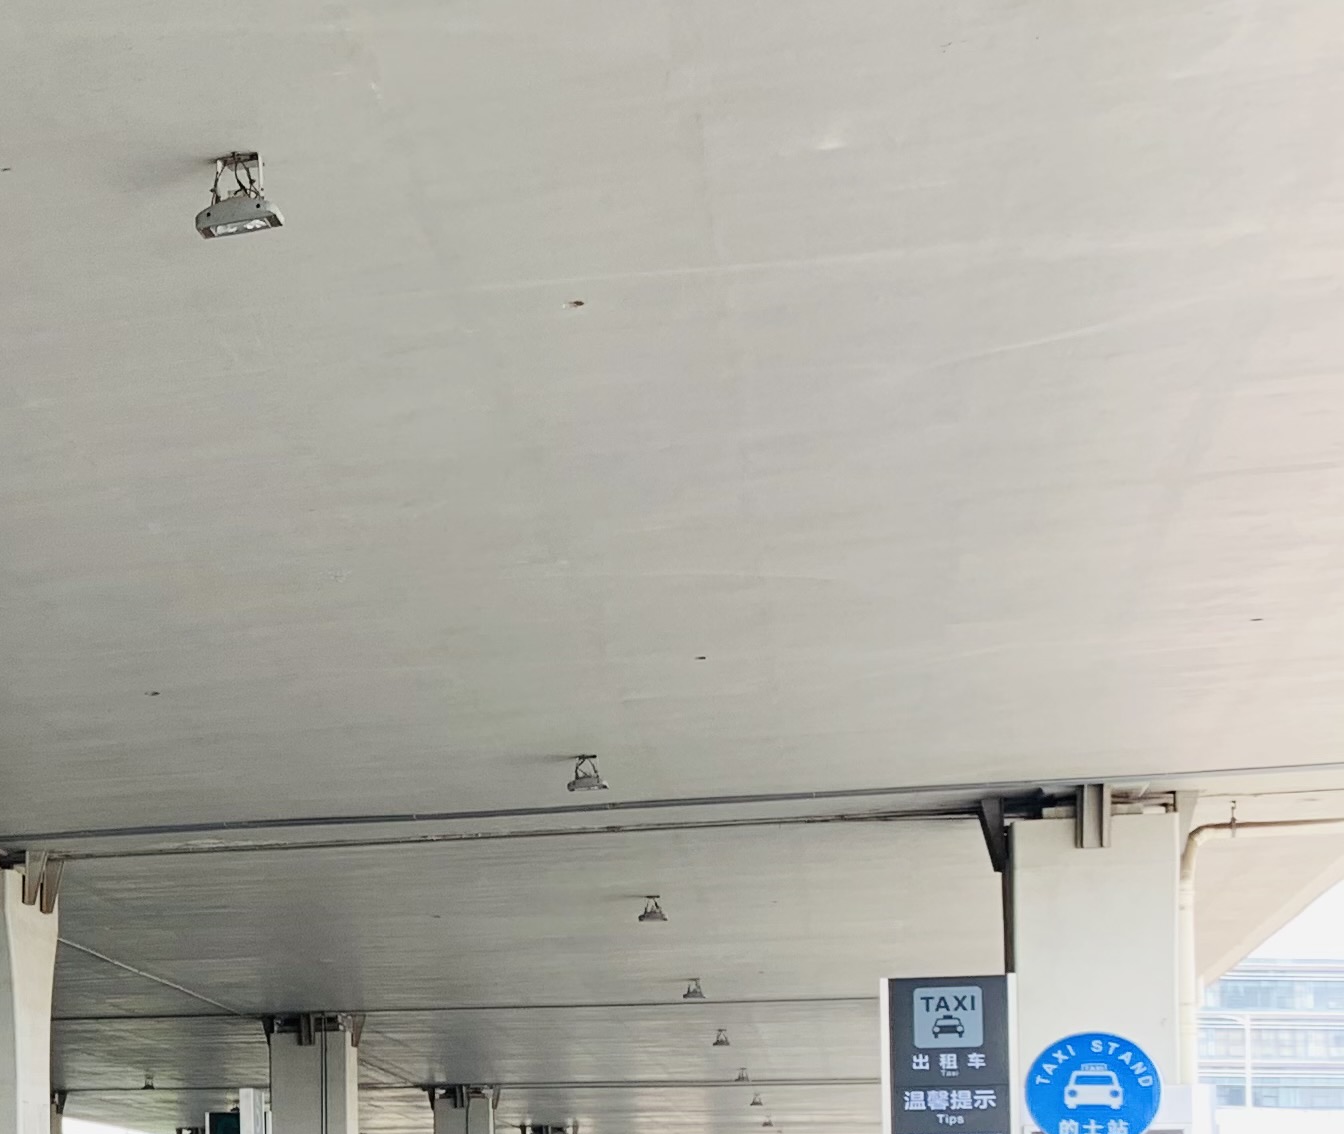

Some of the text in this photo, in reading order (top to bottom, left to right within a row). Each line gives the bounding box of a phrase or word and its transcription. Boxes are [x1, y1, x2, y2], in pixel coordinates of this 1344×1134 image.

[920, 995, 976, 1012] TAXI
[912, 1052, 987, 1071] 出租车
[1035, 1039, 1154, 1088] TAXI STAND
[904, 1089, 997, 1111] 温馨提示
[936, 1114, 965, 1126] Tips
